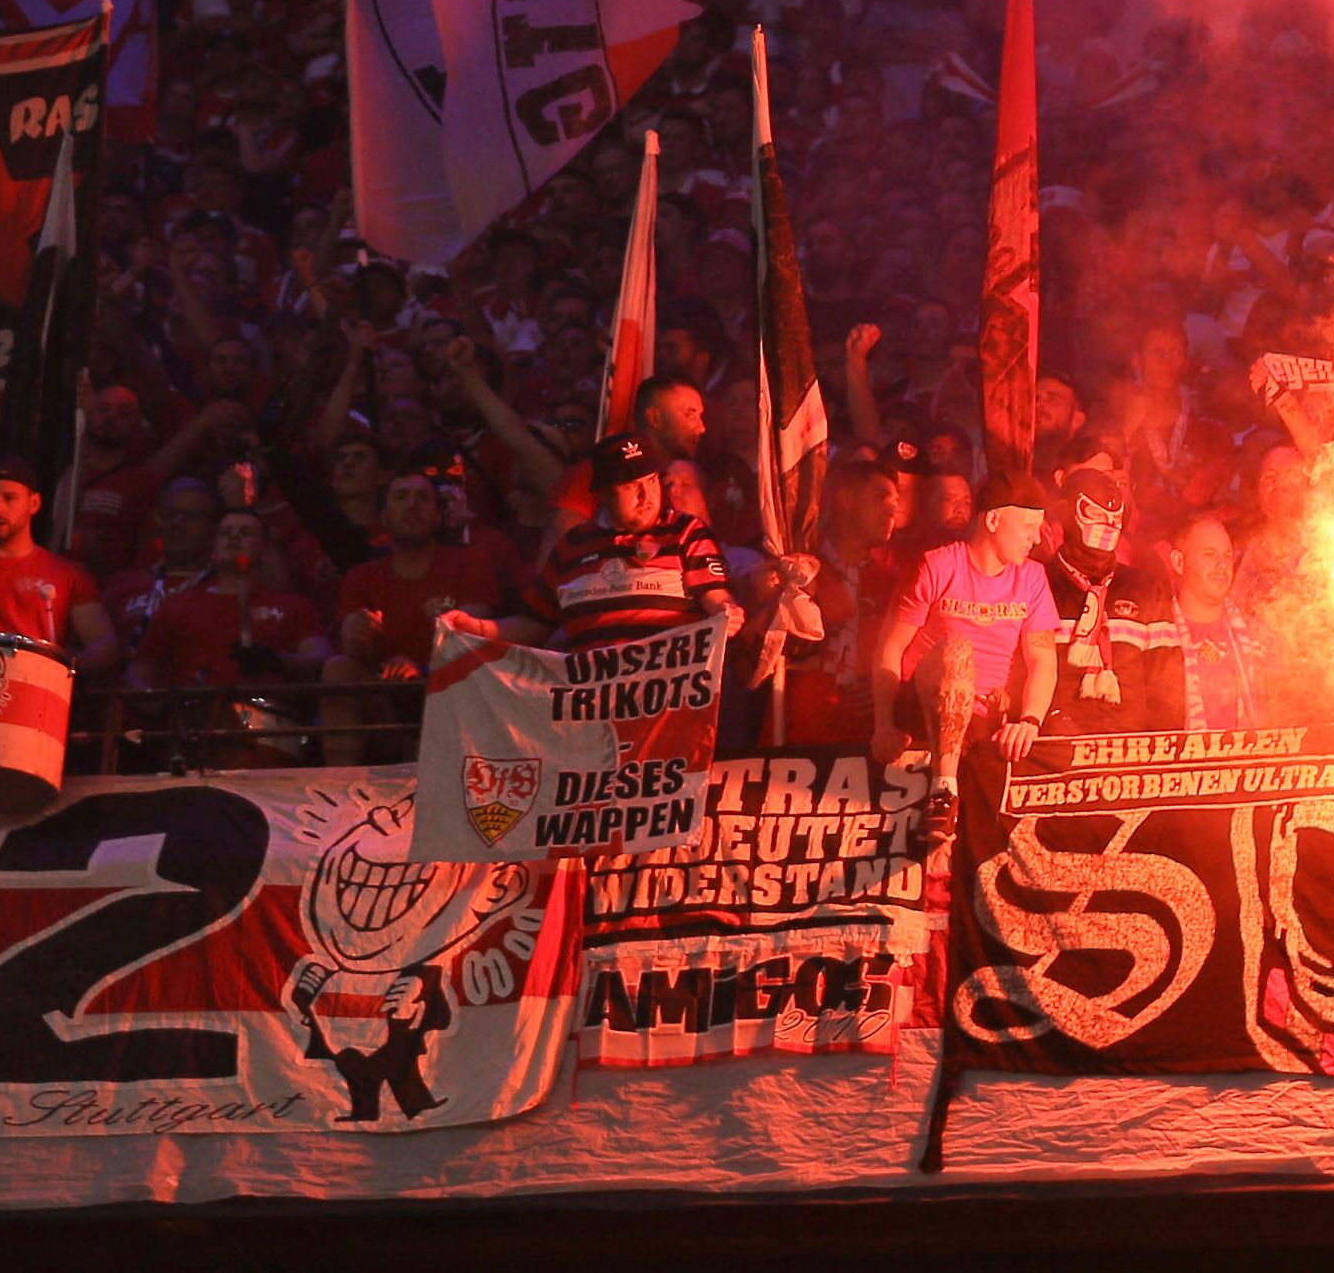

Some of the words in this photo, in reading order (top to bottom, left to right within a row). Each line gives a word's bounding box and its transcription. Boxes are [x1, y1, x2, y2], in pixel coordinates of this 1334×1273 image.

[9, 83, 99, 144] RAS
[635, 580, 664, 592] Bank
[564, 625, 715, 687] UNSERE
[549, 670, 714, 723] TRIKOTS
[1070, 735, 1178, 767] EHRE
[1179, 727, 1309, 759] ALLEN
[554, 758, 687, 807] DIESES
[1008, 768, 1246, 809] VERSTORBENEN
[535, 794, 697, 848] WAPPEN
[589, 857, 924, 917] WIDERSTAND
[3, 1088, 307, 1135] Stuttgart
